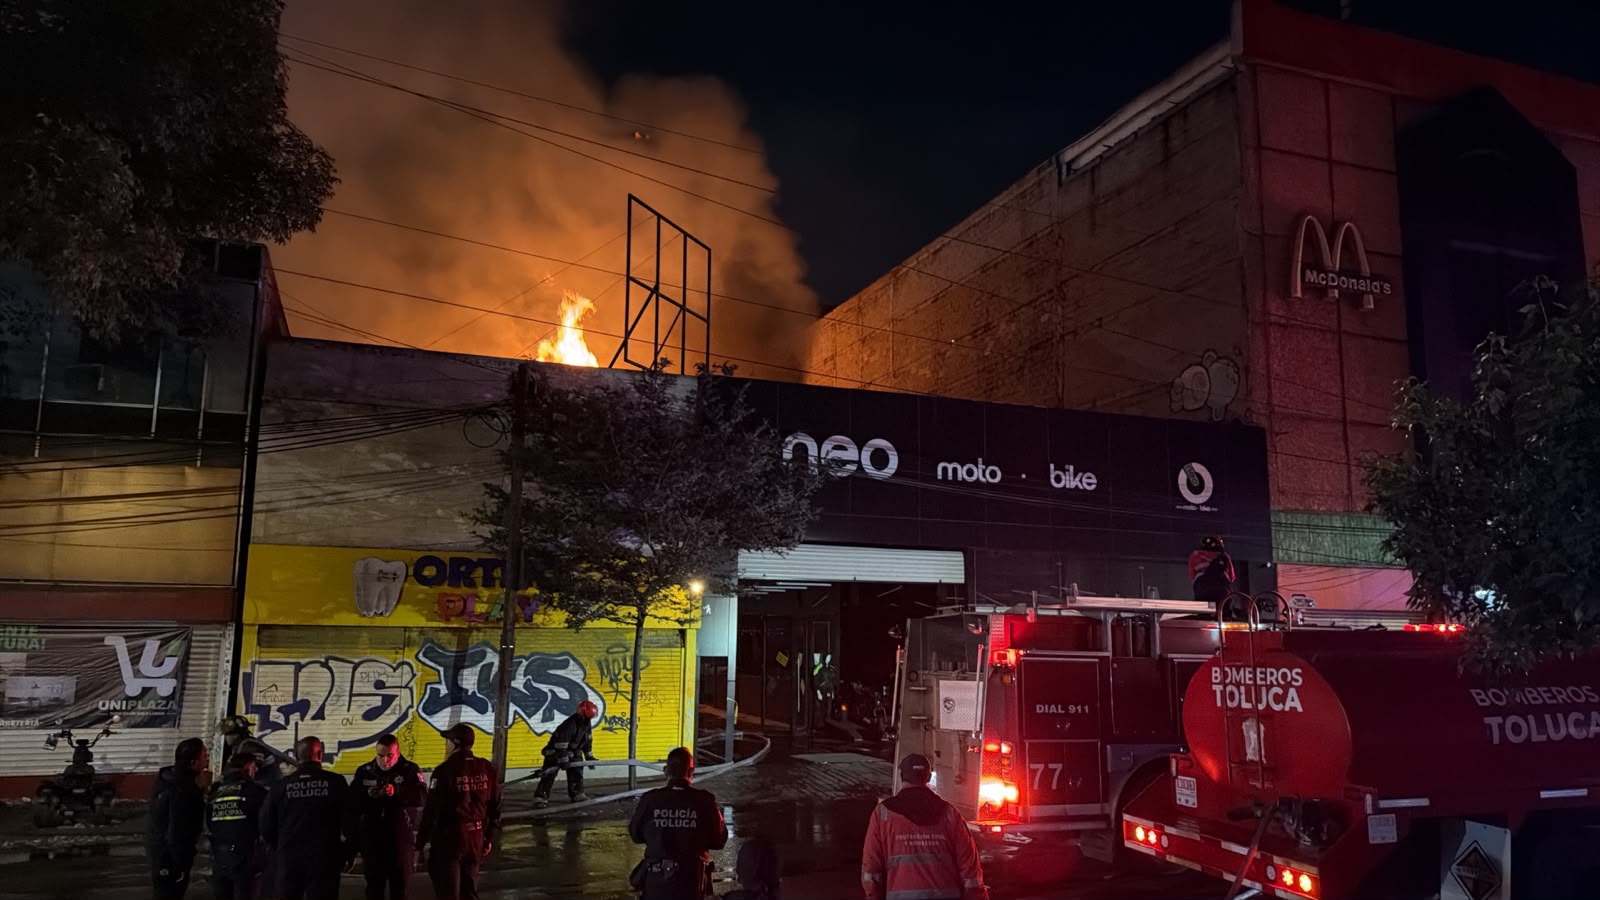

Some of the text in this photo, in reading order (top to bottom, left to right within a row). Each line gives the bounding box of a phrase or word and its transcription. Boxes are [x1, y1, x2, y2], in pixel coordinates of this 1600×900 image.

[1304, 269, 1392, 295] McDonald's
[782, 431, 899, 481] neo
[936, 457, 1098, 491] moto bike
[97, 699, 177, 711] UNIPLAZA
[1035, 704, 1089, 714] DIAL 911
[1211, 684, 1304, 712] TOLUCA
[1029, 763, 1063, 790] 77
[286, 788, 329, 799] TOLUCA
[653, 818, 698, 829] TOLUCA
